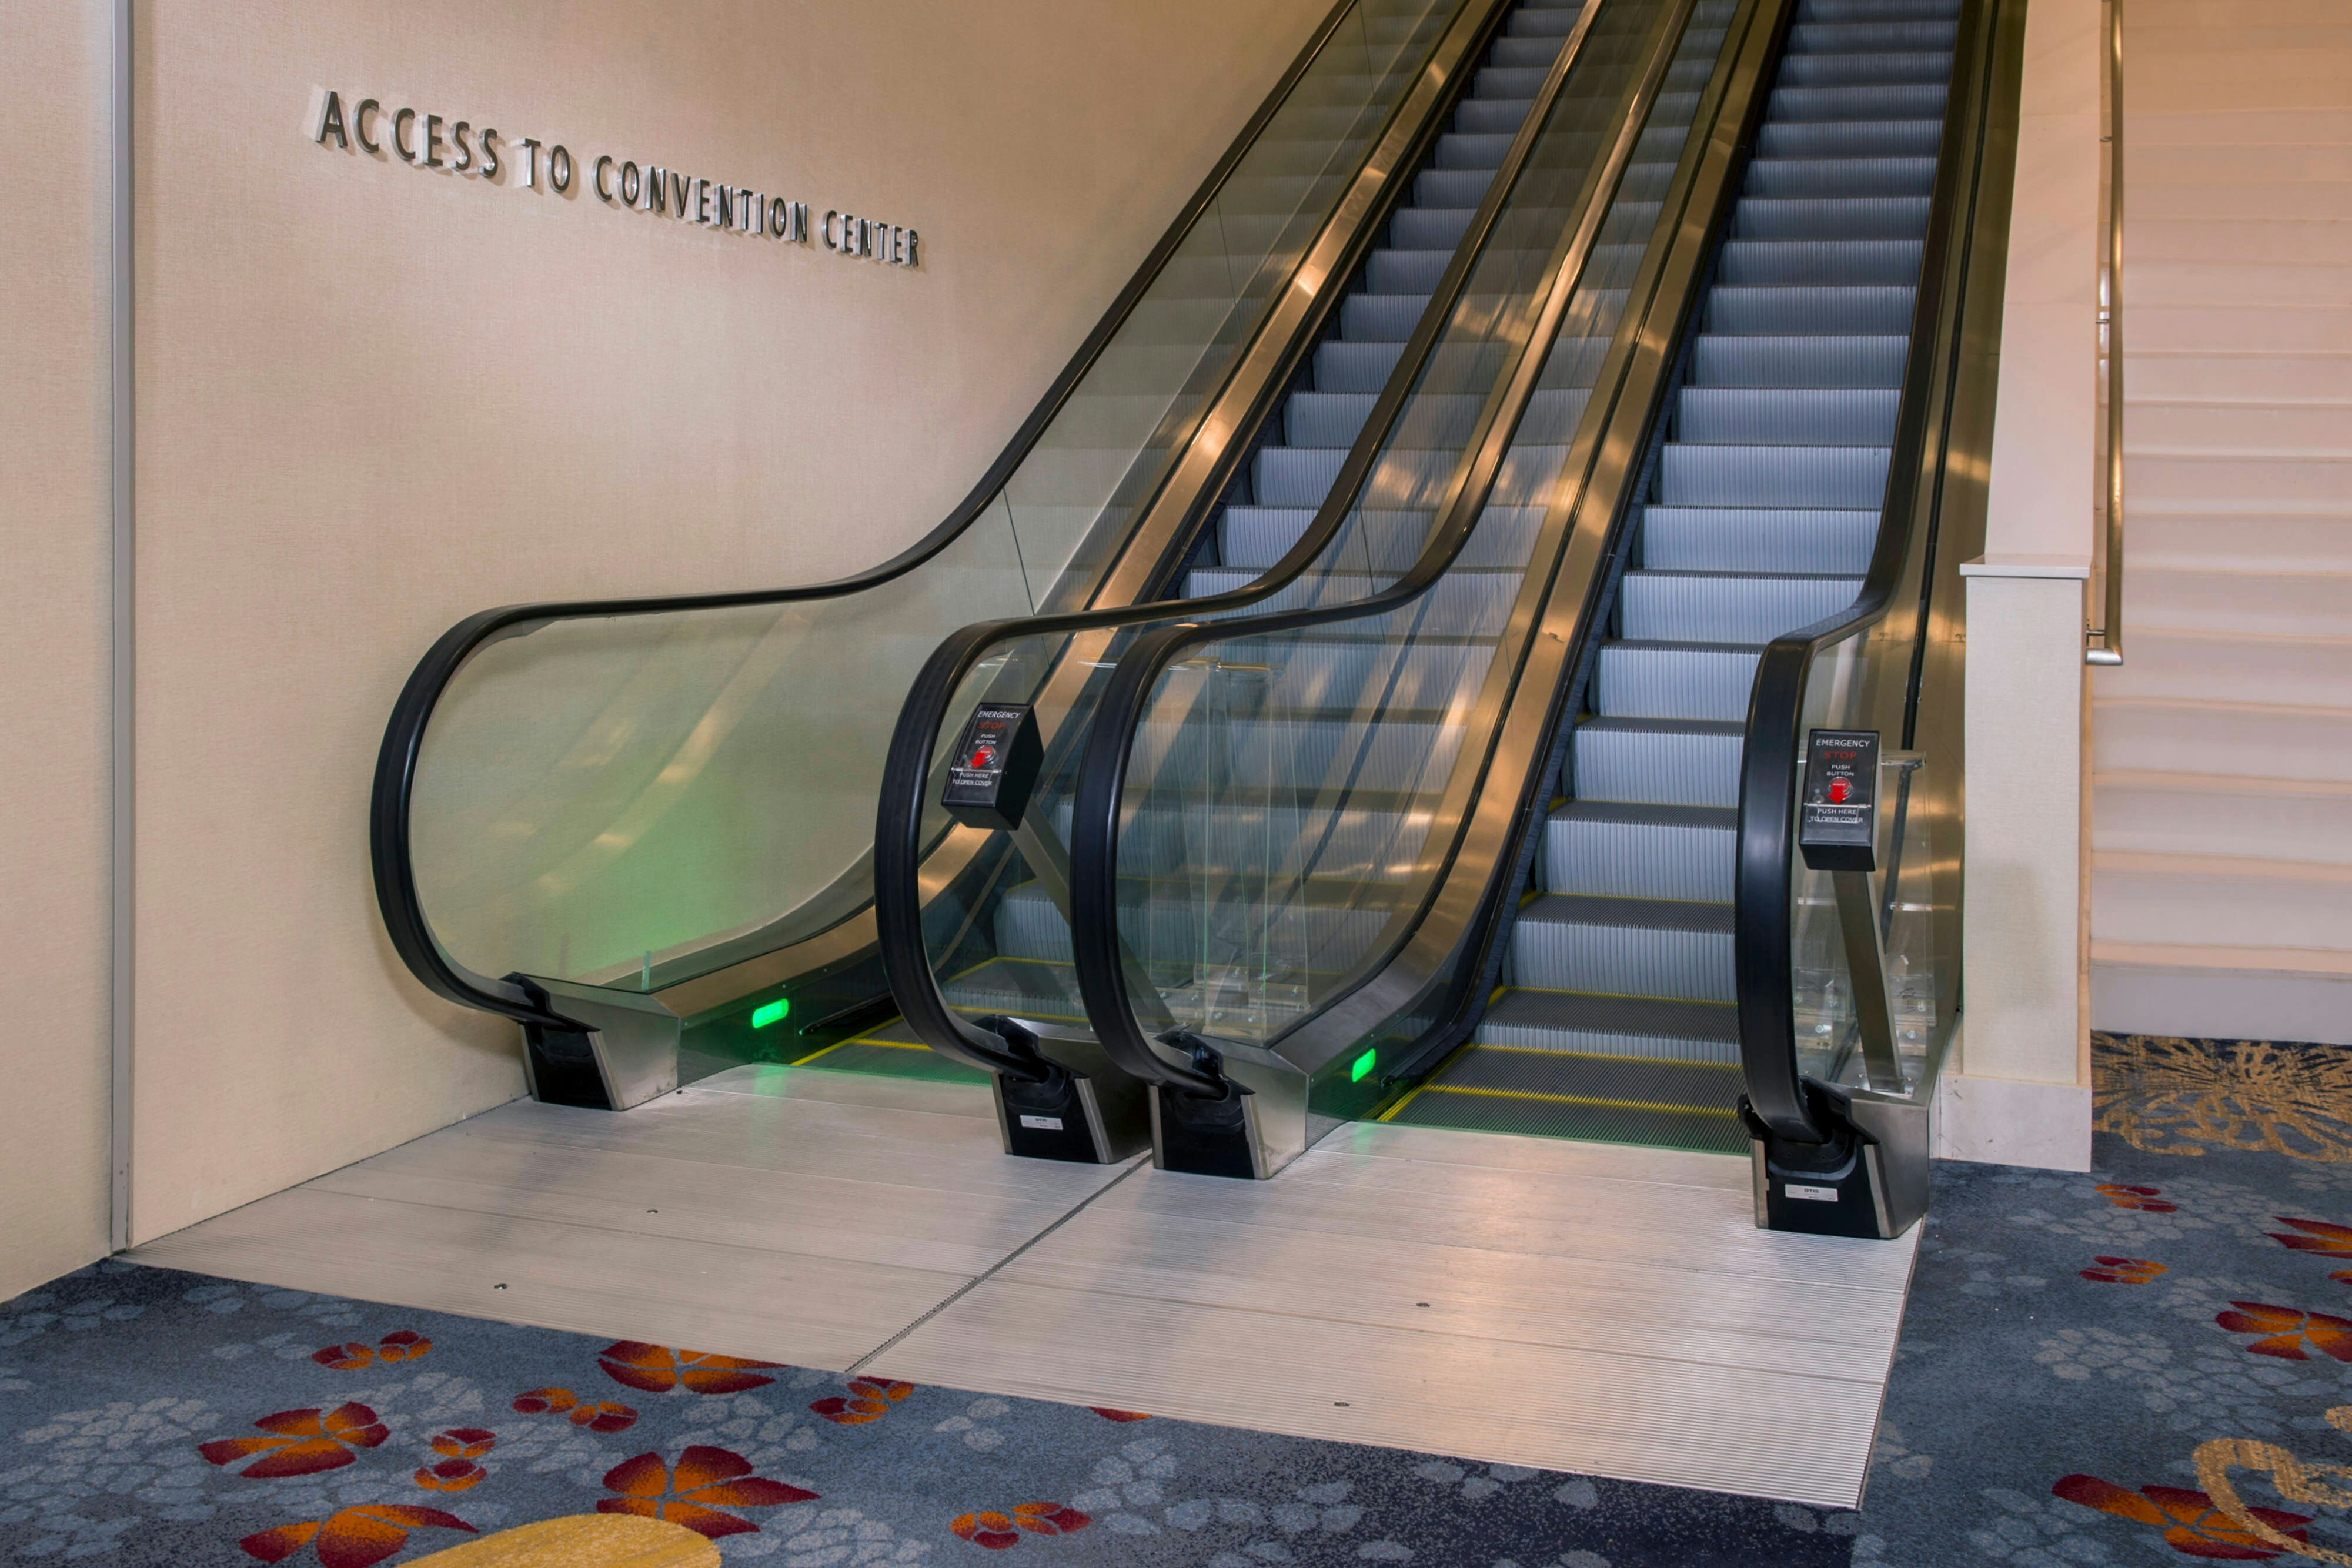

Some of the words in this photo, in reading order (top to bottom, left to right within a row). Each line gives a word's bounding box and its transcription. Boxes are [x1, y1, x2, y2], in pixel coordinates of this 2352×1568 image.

[316, 91, 498, 178] ACCESS
[520, 138, 570, 193] TO
[592, 155, 807, 243] CONVENTION
[821, 210, 918, 267] CENTER
[978, 710, 1021, 718] EMERGENCY
[1816, 738, 1870, 747] EMERGENCY
[1824, 751, 1857, 759] STOP
